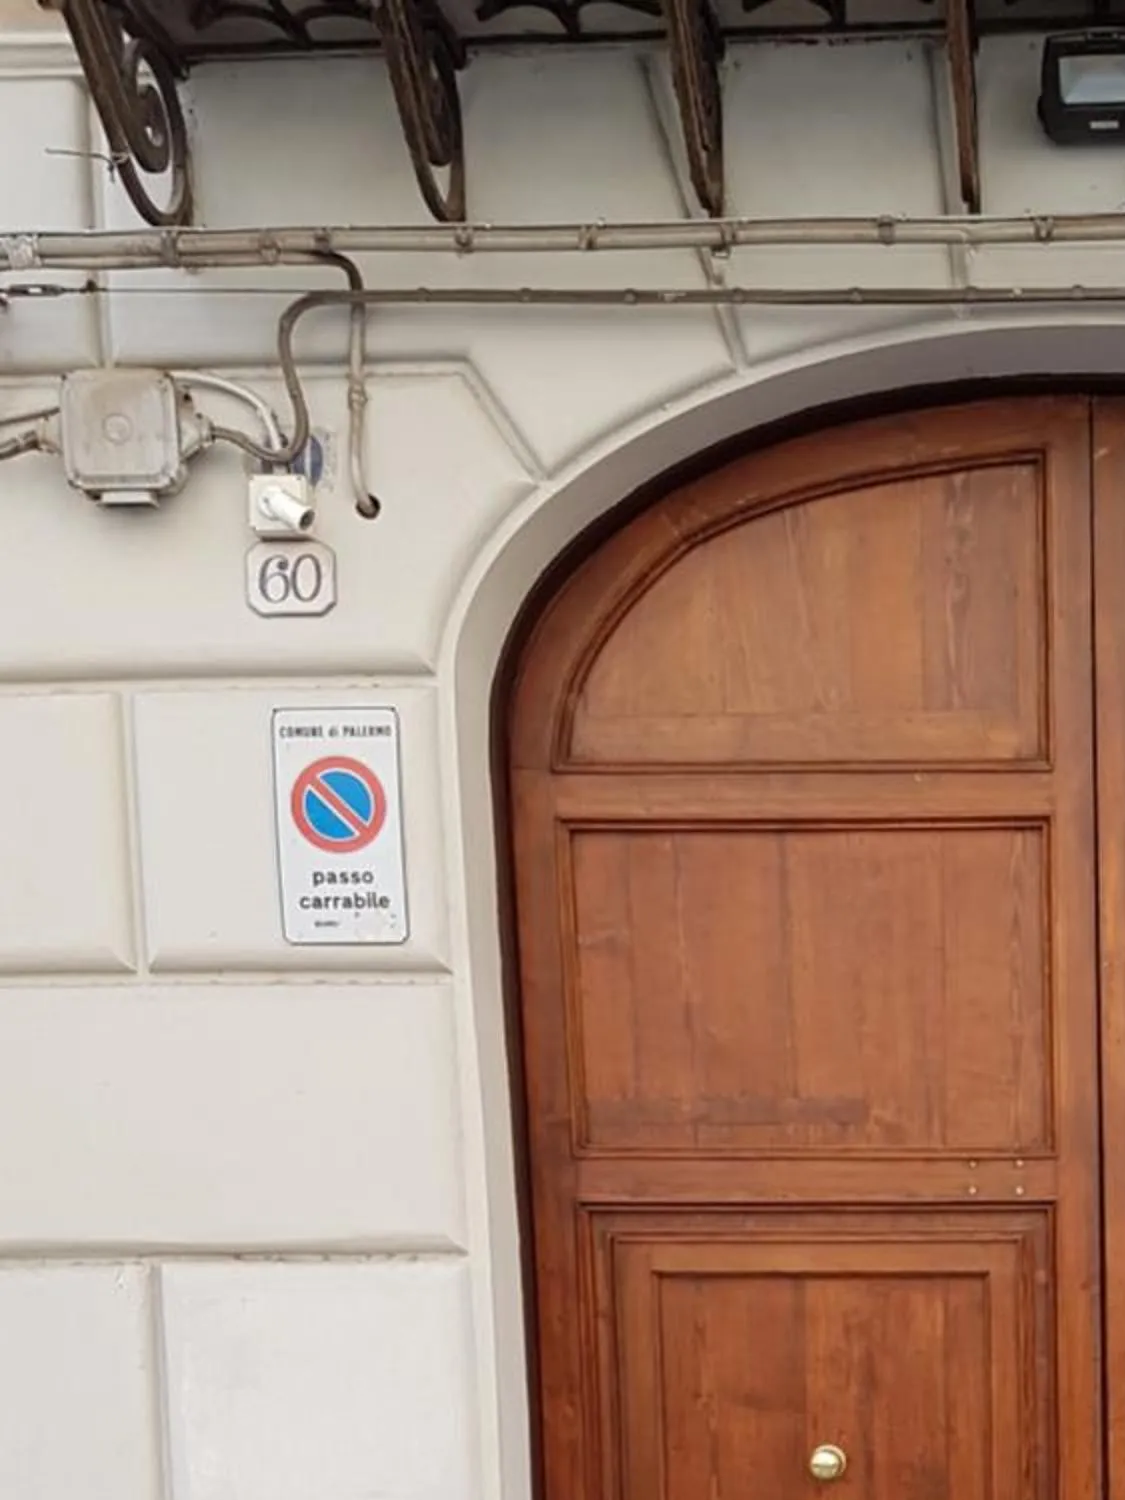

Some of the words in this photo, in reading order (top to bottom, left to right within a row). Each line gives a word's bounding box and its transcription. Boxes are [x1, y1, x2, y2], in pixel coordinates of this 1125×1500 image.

[258, 553, 323, 604] 60
[279, 725, 323, 739] COMUNE
[342, 725, 392, 738] PALERMO
[312, 871, 374, 888] passo
[299, 891, 391, 910] carrabile
